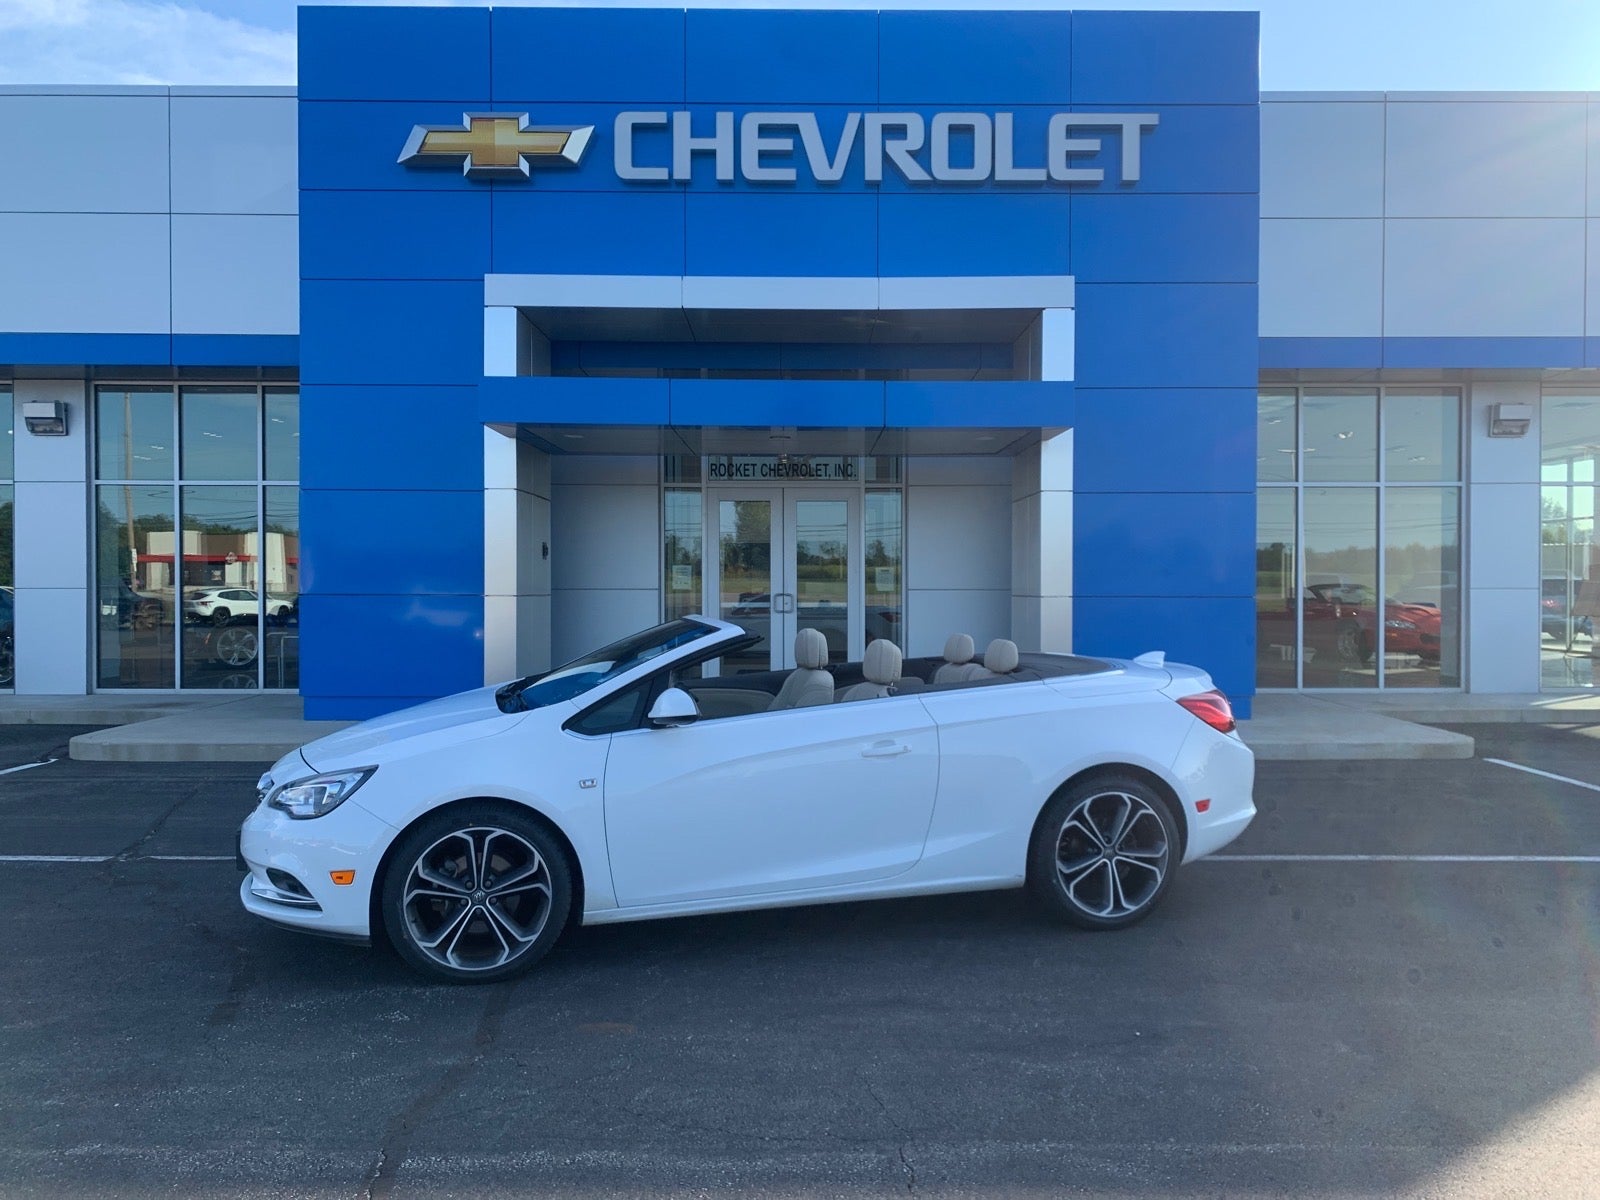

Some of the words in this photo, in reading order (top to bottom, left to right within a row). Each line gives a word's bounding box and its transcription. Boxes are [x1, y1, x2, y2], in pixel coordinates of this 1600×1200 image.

[613, 111, 1160, 183] CHEVROLET
[710, 463, 757, 477] ROCKET
[760, 463, 832, 479] CHEVROLET,
[834, 463, 857, 478] INC.
